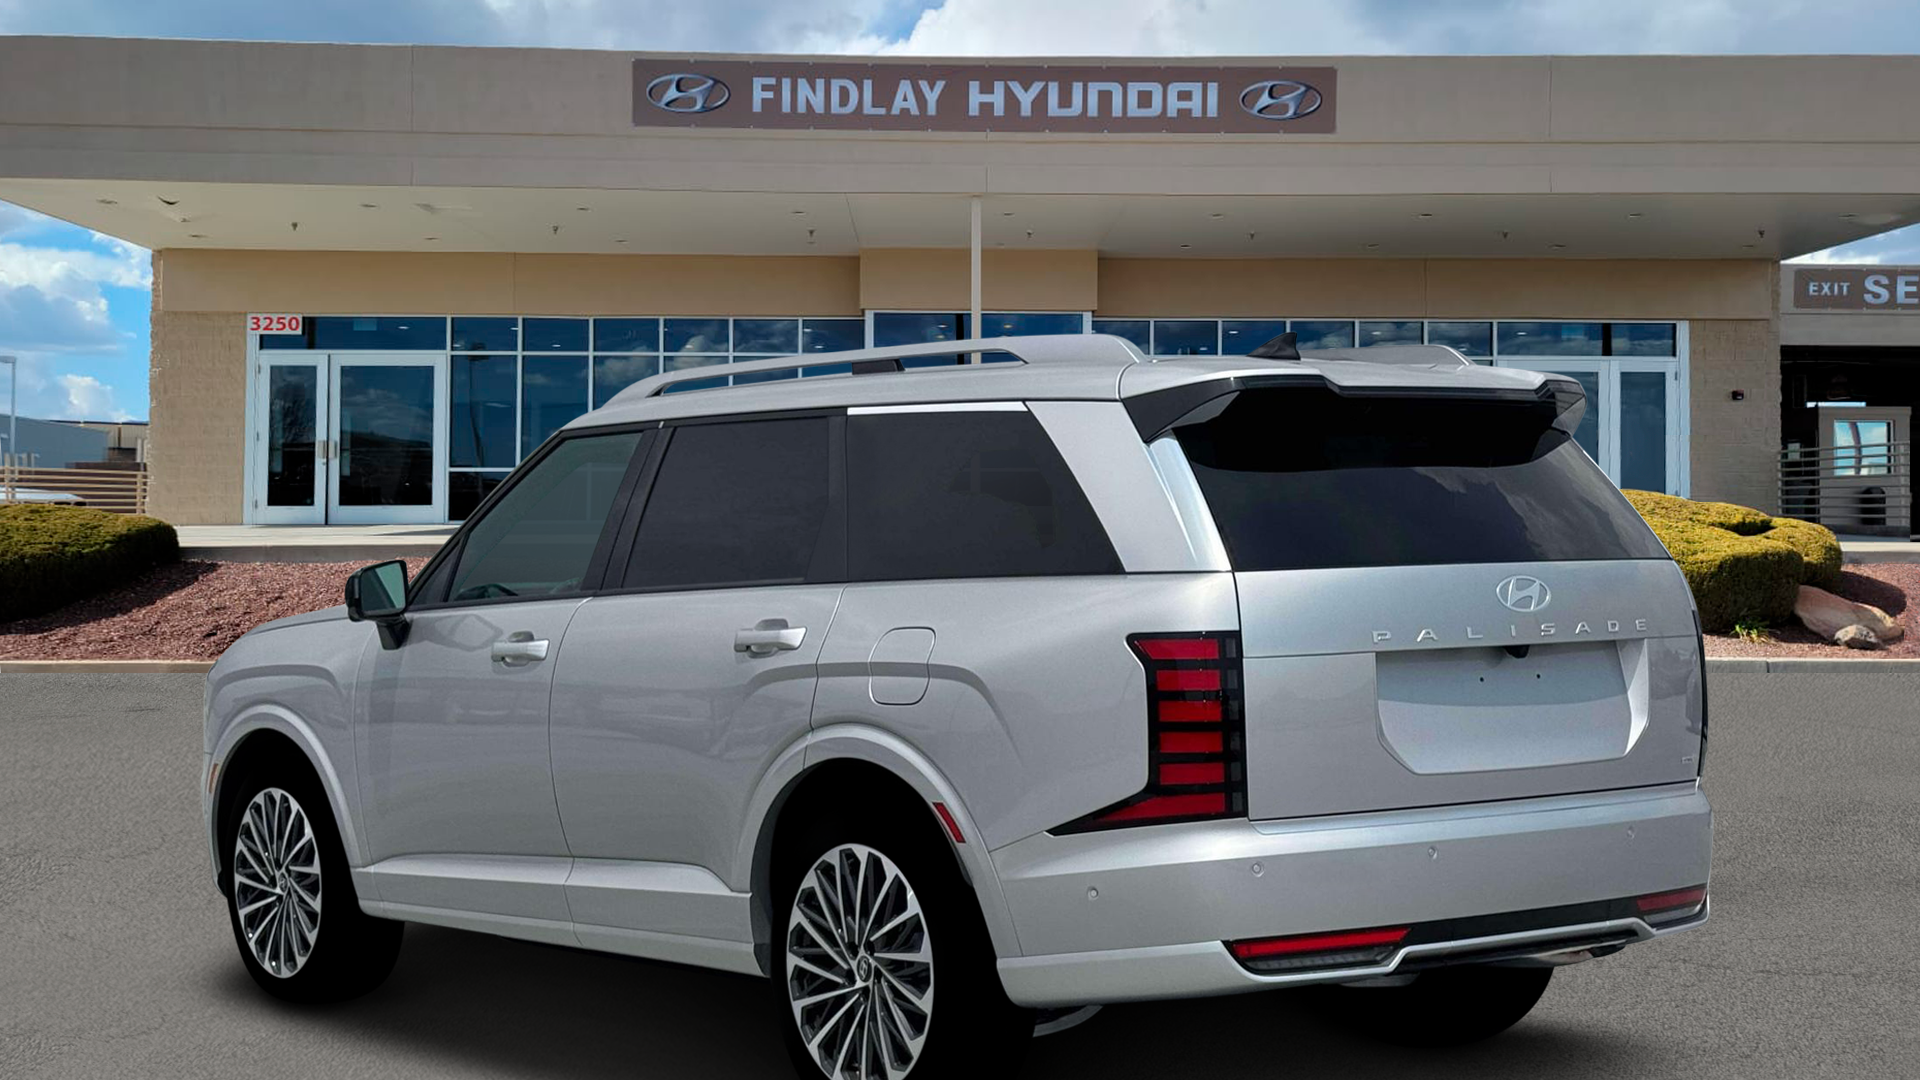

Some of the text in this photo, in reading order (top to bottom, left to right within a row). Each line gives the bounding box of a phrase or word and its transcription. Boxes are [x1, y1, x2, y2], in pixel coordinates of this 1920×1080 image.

[751, 76, 1218, 119] FINDLAY HYUNDAI
[1808, 281, 1850, 296] EXIT
[249, 315, 300, 331] 3250
[1371, 618, 1648, 644] PALISADE
